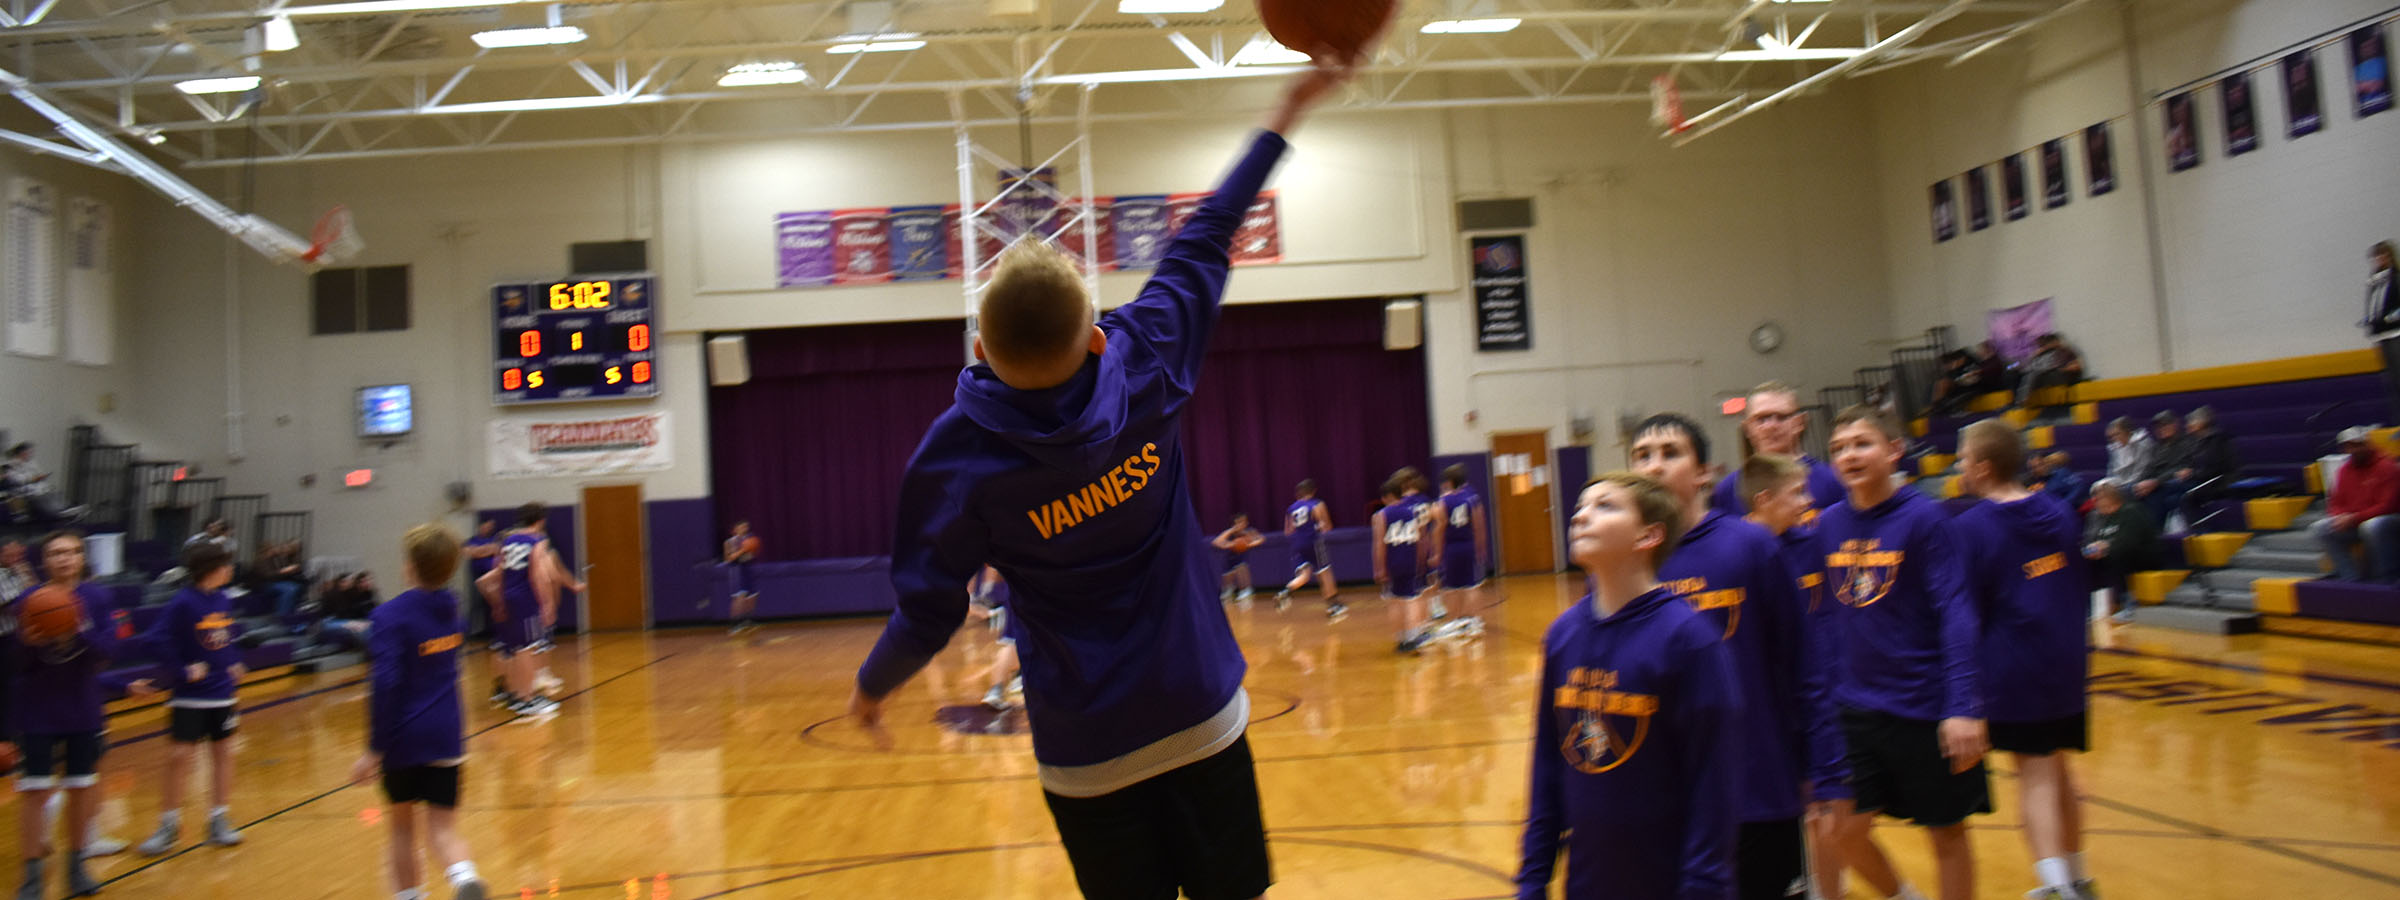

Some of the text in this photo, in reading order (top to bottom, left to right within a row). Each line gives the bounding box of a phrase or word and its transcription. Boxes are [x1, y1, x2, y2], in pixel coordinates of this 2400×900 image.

[520, 330, 541, 357] 0
[571, 331, 583, 351] 1
[628, 323, 650, 352] 0
[1026, 442, 1161, 540] VANNESS
